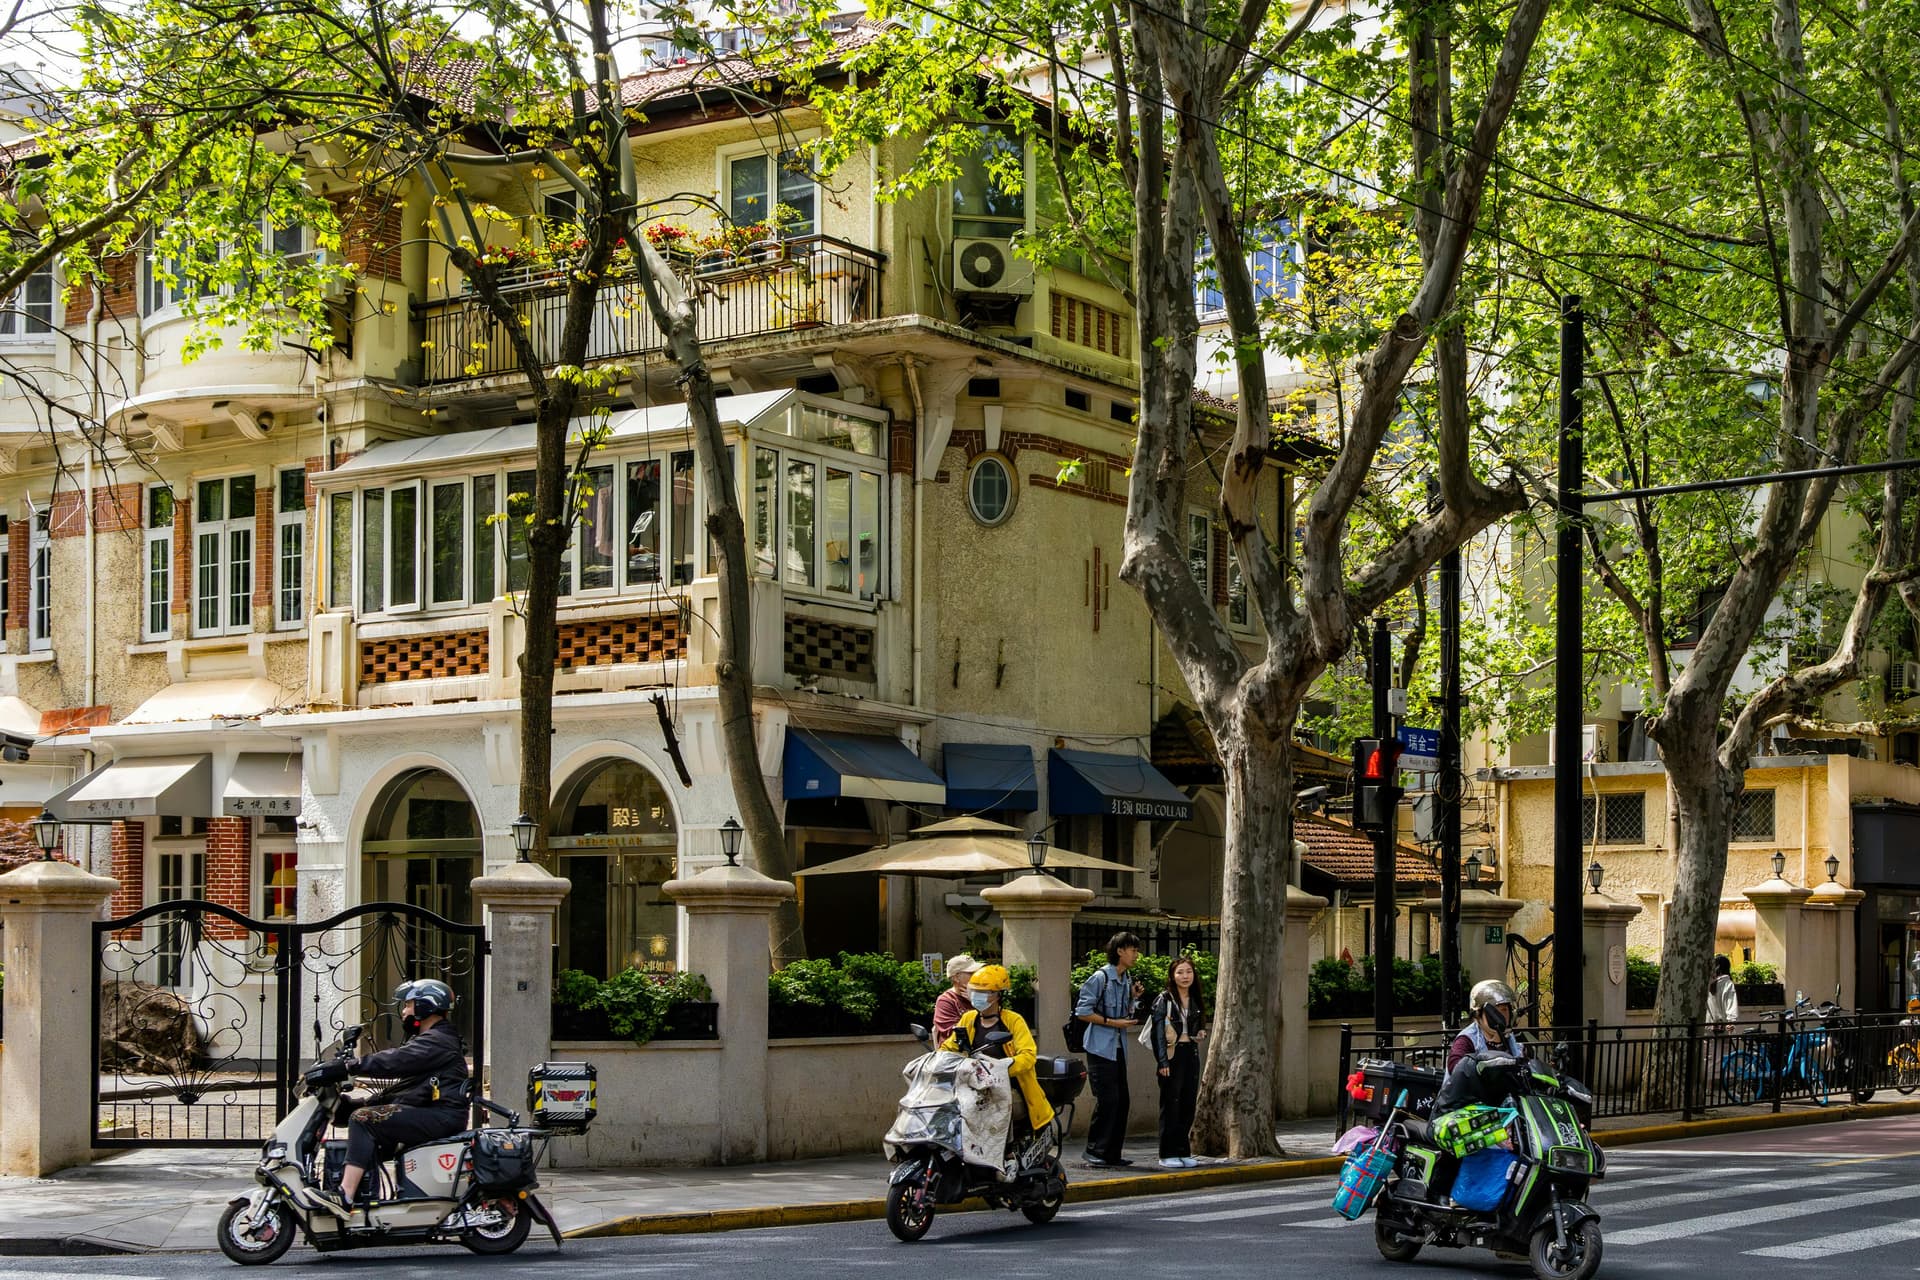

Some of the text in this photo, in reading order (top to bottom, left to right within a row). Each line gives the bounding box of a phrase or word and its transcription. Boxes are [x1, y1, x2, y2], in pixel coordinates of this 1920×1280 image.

[1111, 799, 1188, 819] 红领 RED COLLAR
